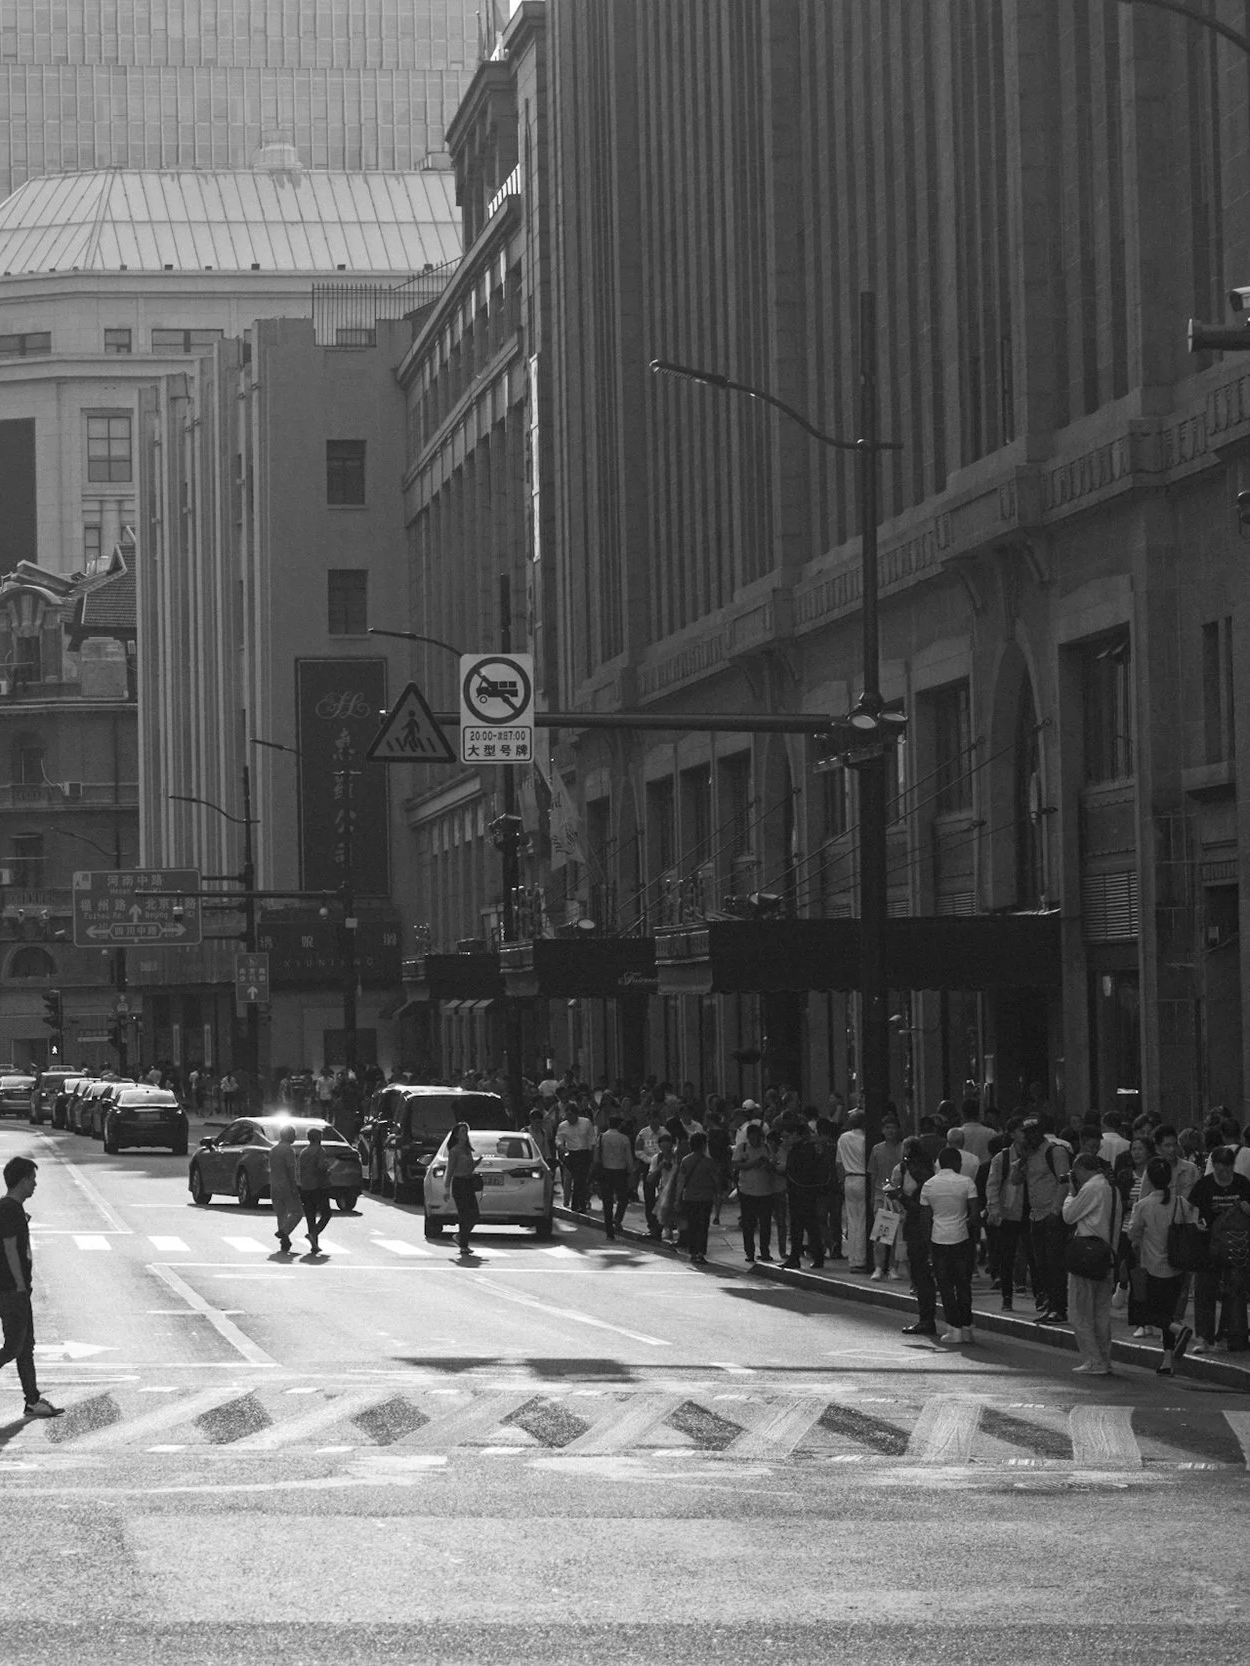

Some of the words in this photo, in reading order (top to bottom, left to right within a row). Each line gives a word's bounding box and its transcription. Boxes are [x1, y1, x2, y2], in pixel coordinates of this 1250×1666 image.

[467, 744, 528, 757] 大型号牌
[106, 874, 163, 887] 河南中路
[80, 898, 126, 911] 福州路
[114, 926, 158, 937] 四川中路
